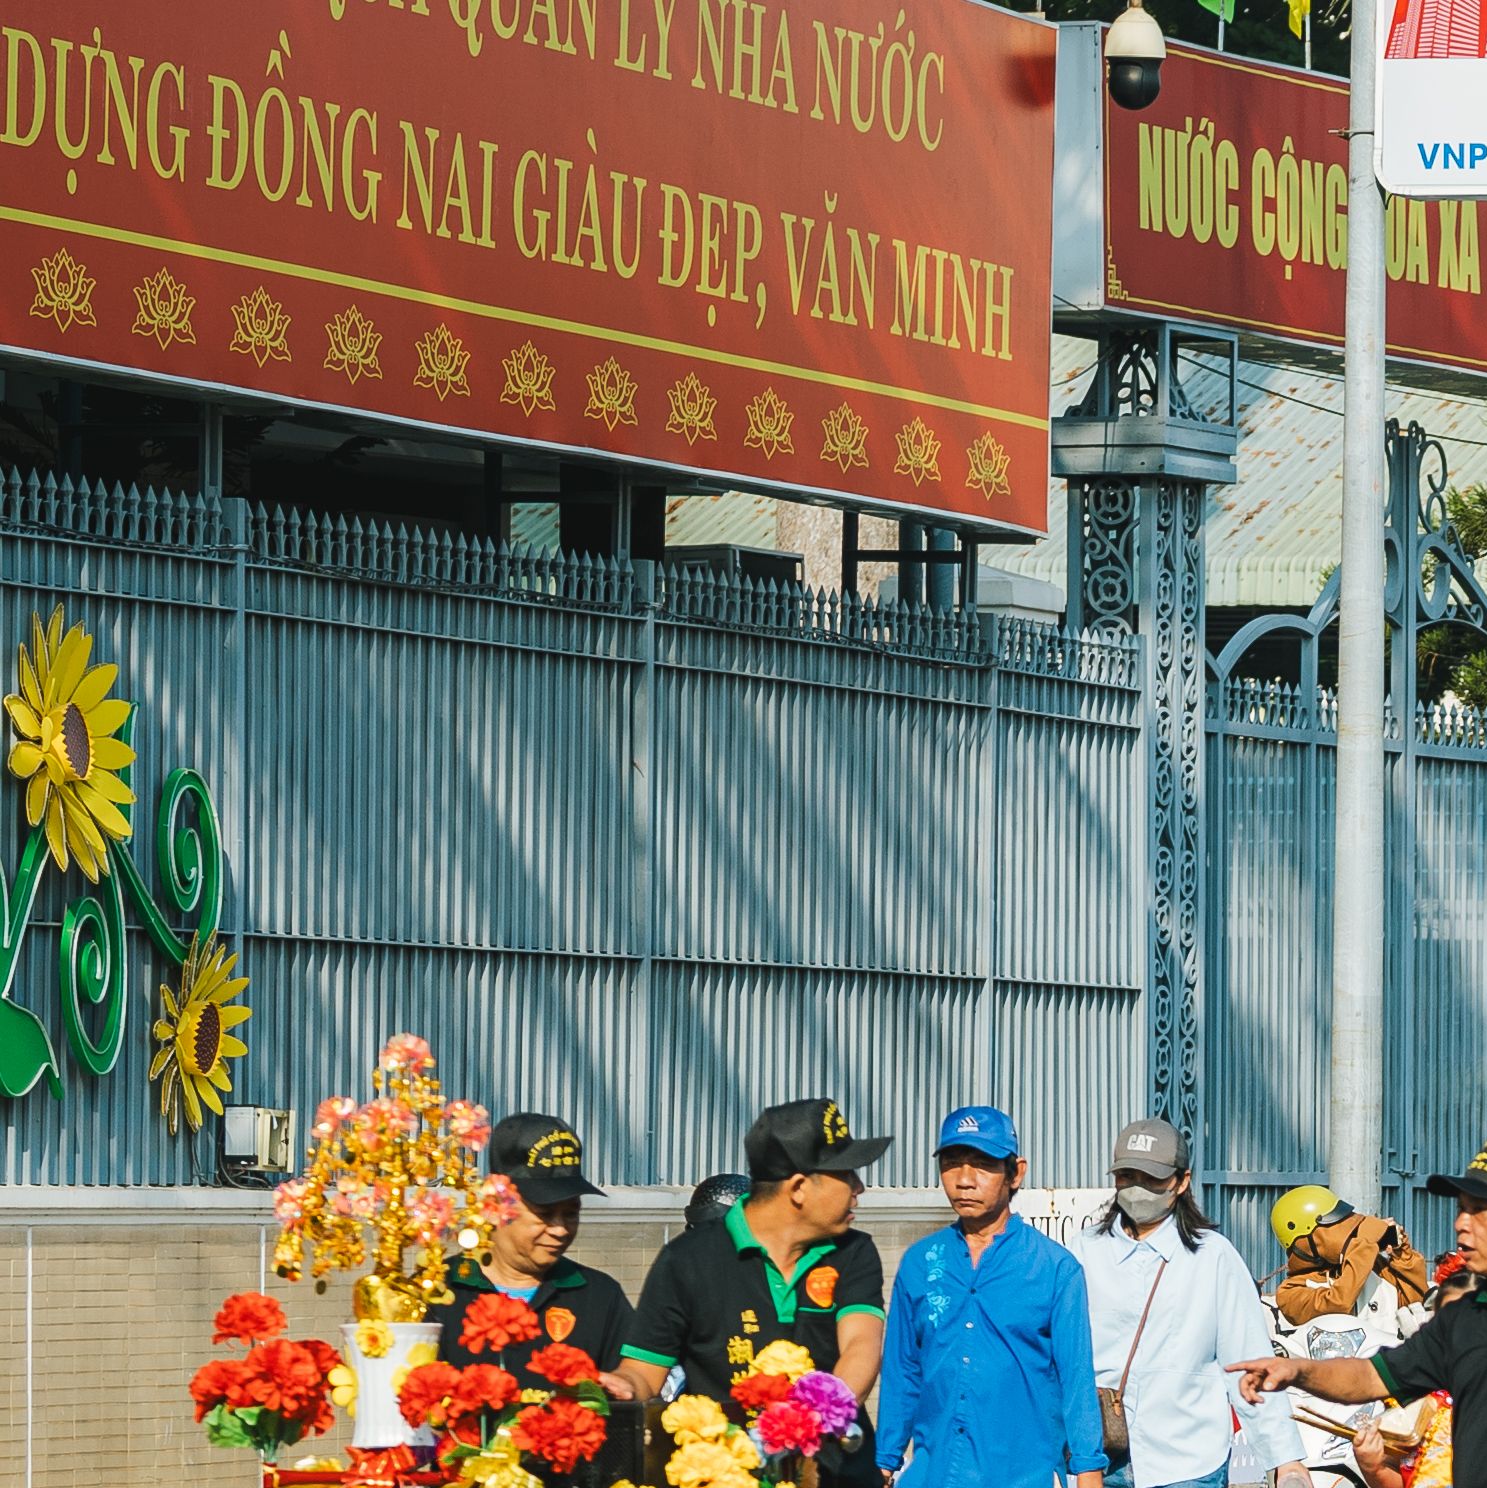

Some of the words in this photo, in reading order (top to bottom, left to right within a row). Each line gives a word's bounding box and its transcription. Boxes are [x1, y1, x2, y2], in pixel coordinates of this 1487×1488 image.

[811, 9, 944, 151] NƯỚC
[0, 26, 190, 195] DỰNG
[206, 30, 382, 224] ĐỒNG
[397, 120, 498, 249] NAI
[513, 128, 647, 280] GIÀU
[658, 183, 767, 330] ĐẸP,
[780, 190, 880, 330] VĂN
[890, 239, 1014, 361] MINH
[1139, 116, 1239, 248] NƯỚC
[1252, 135, 1347, 281] CỘNG
[1127, 1134, 1158, 1152] CAT
